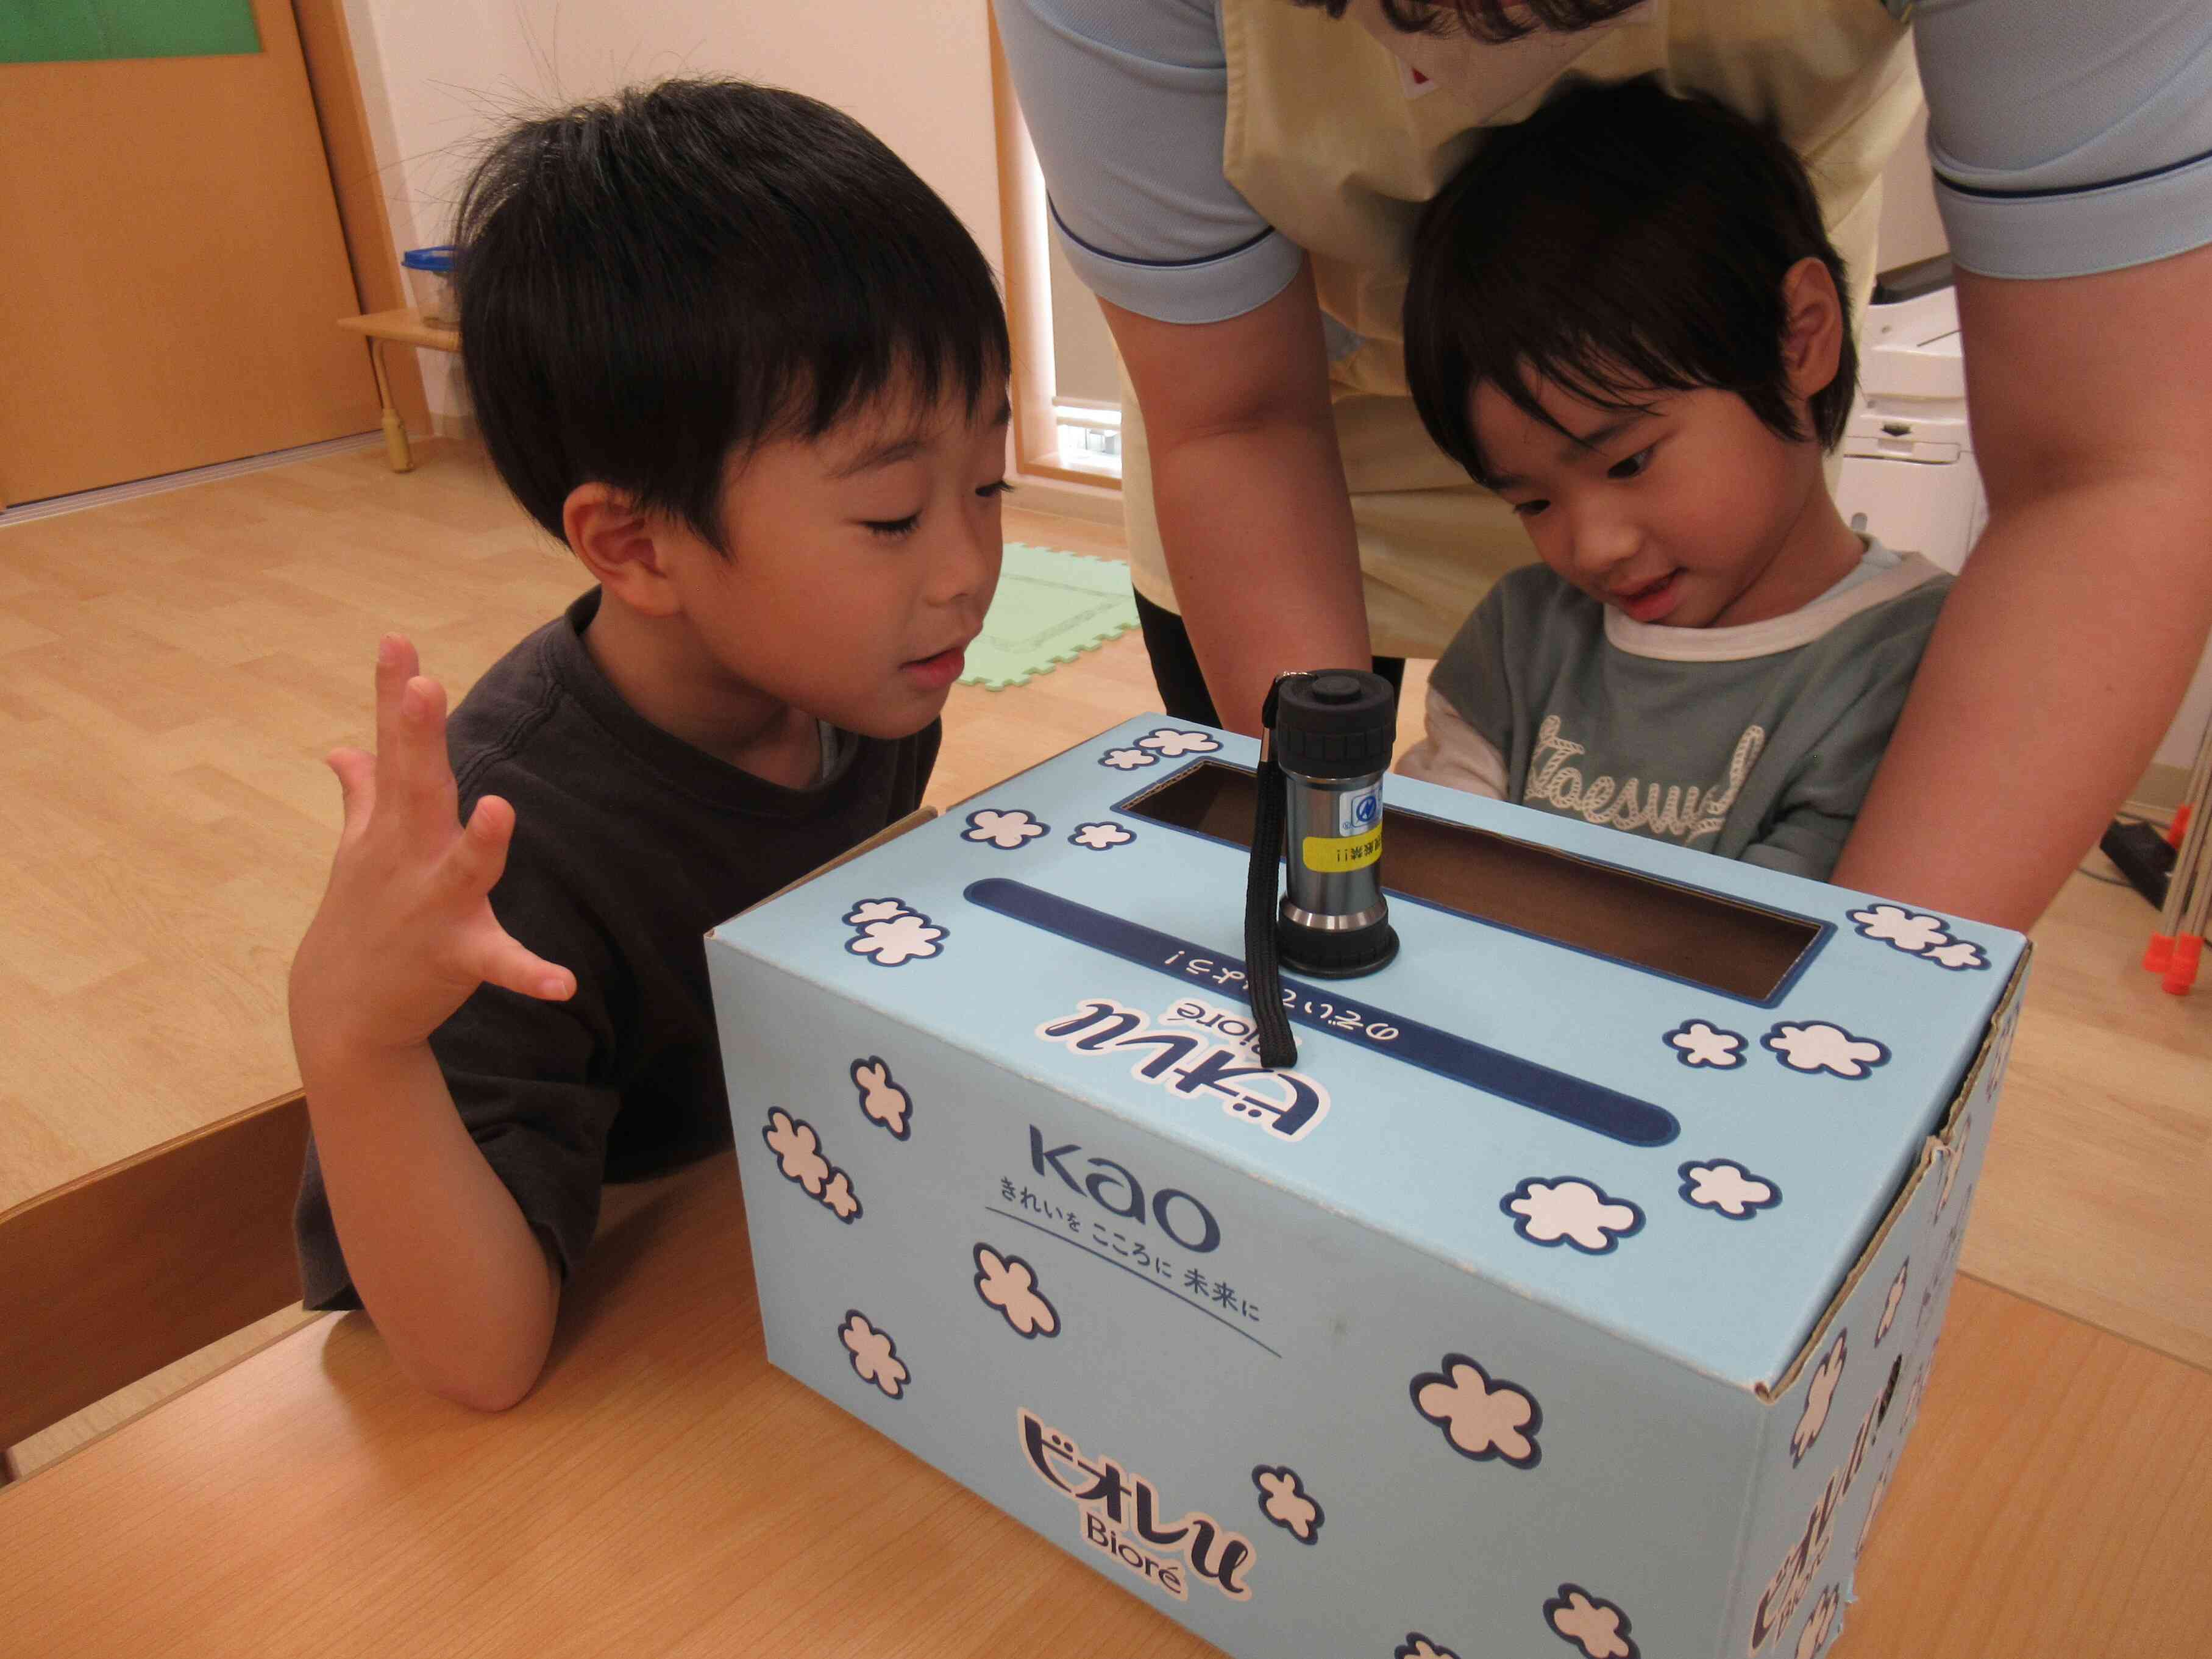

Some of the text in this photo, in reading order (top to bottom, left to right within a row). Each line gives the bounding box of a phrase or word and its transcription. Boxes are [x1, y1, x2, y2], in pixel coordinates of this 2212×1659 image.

[1165, 950, 1399, 1040] のぞいてよう!
[1166, 1001, 1262, 1056] ioré
[1000, 1176, 1260, 1322] きれいを こころに 未来に
[1086, 1511, 1181, 1594] Bioré
